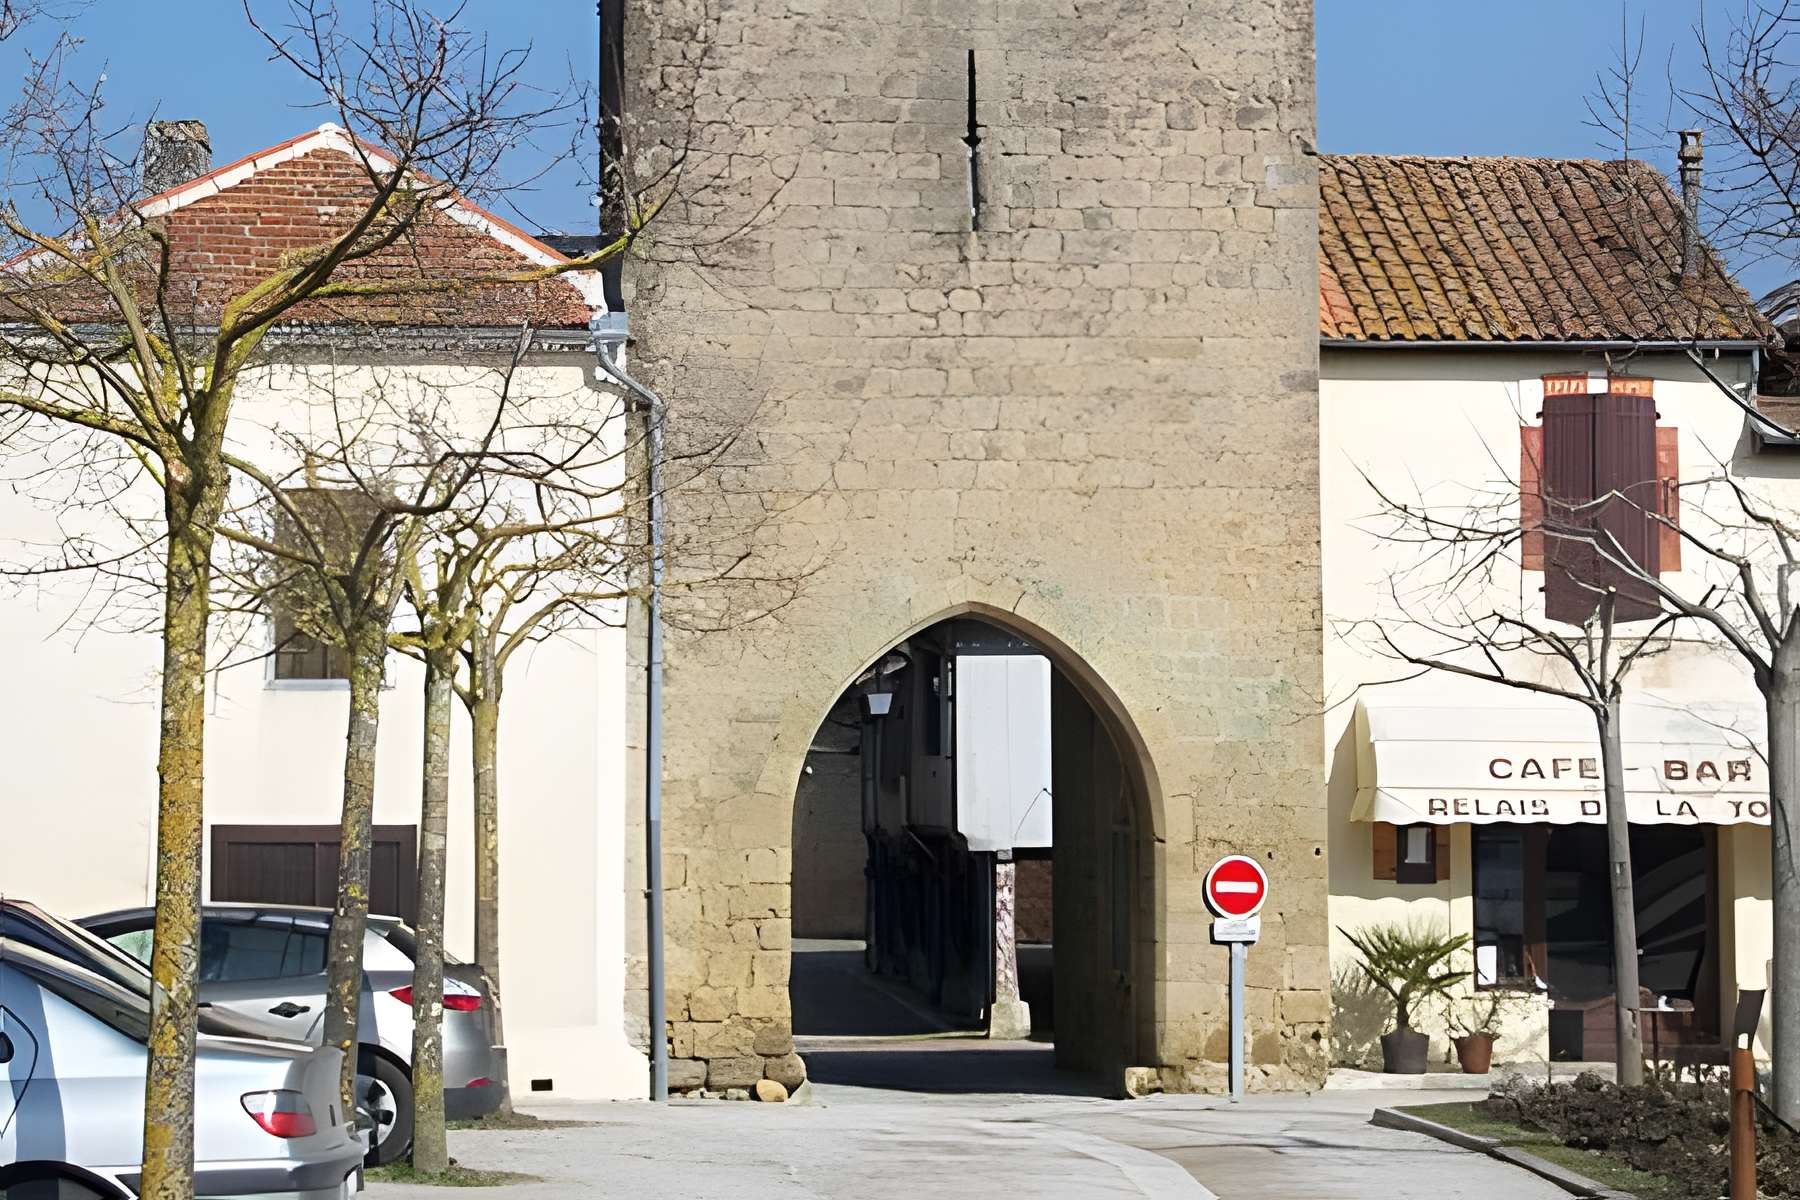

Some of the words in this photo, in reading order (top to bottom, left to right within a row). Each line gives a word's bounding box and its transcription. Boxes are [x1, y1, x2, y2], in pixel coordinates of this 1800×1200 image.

[1488, 757, 1601, 780] CAFE
[1663, 759, 1752, 782] BAR
[1428, 798, 1550, 817] RELAIS
[1579, 799, 1602, 817] D
[1656, 799, 1699, 817] LA
